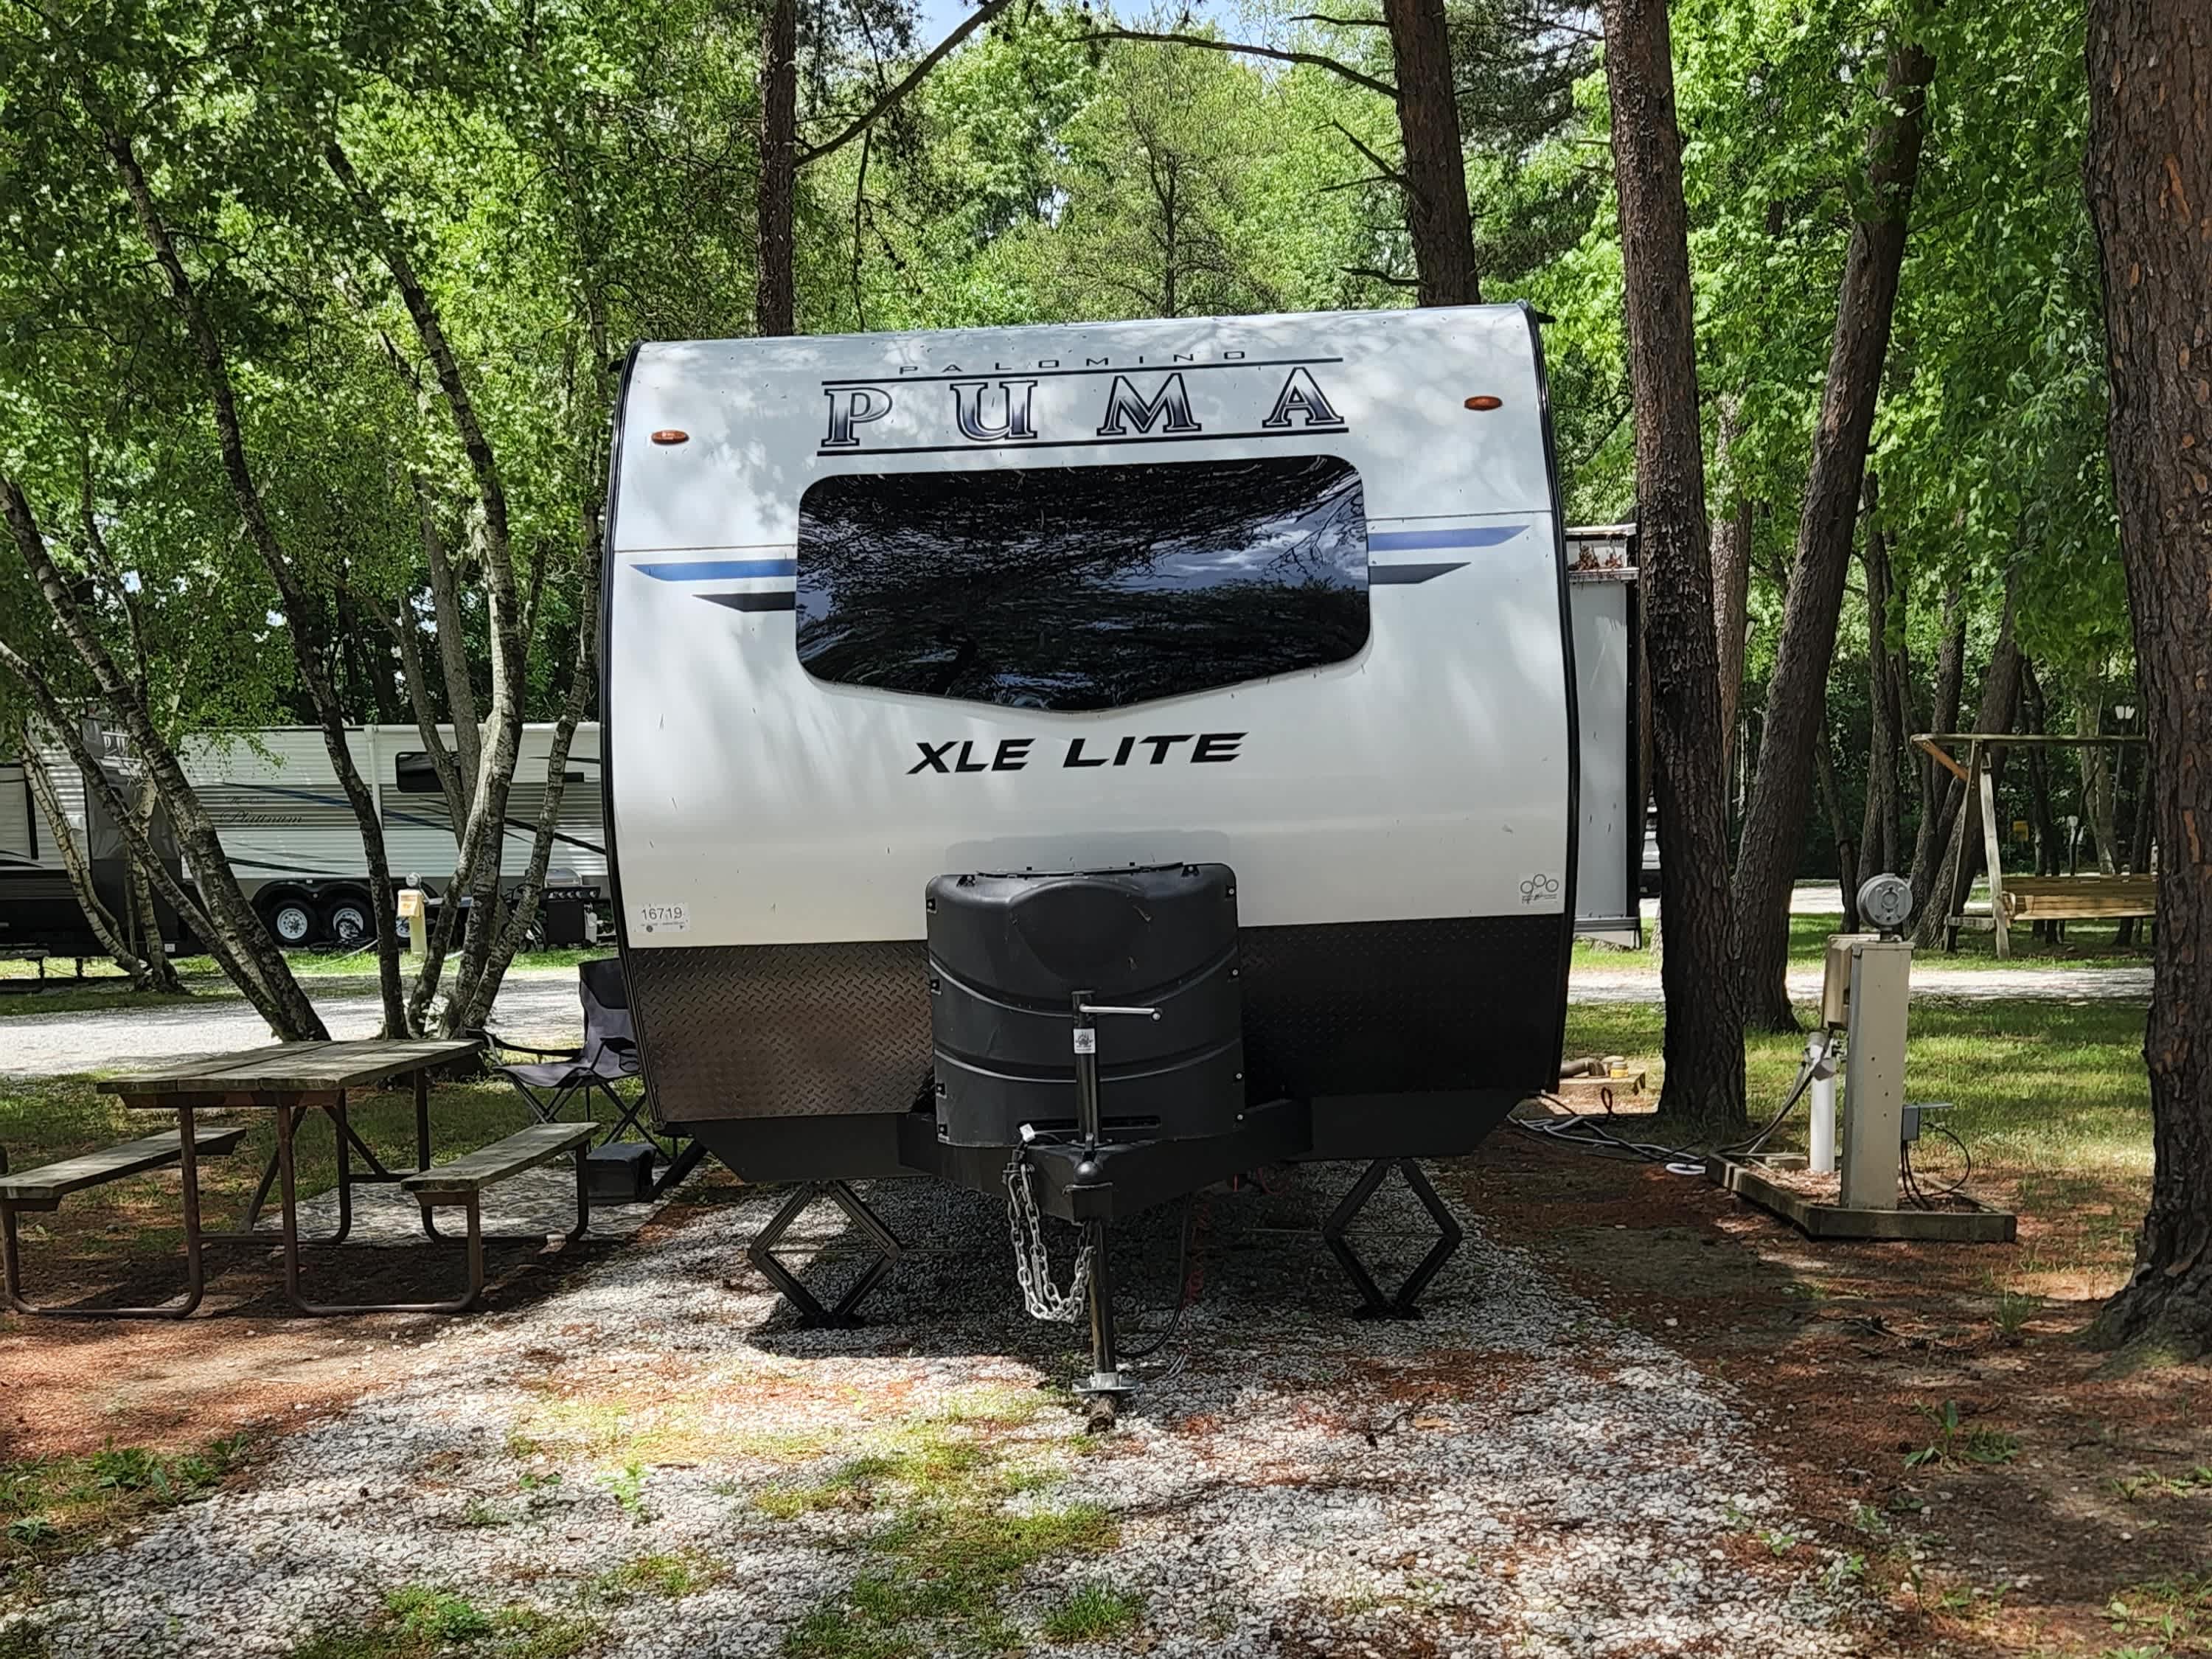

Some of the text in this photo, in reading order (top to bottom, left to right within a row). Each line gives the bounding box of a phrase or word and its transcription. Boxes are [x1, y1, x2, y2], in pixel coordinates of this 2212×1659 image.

[900, 350, 1245, 374] PALOMINO
[821, 367, 1343, 447] PUMA
[905, 732, 1249, 774] XLE LITE
[641, 907, 683, 920] 16719
